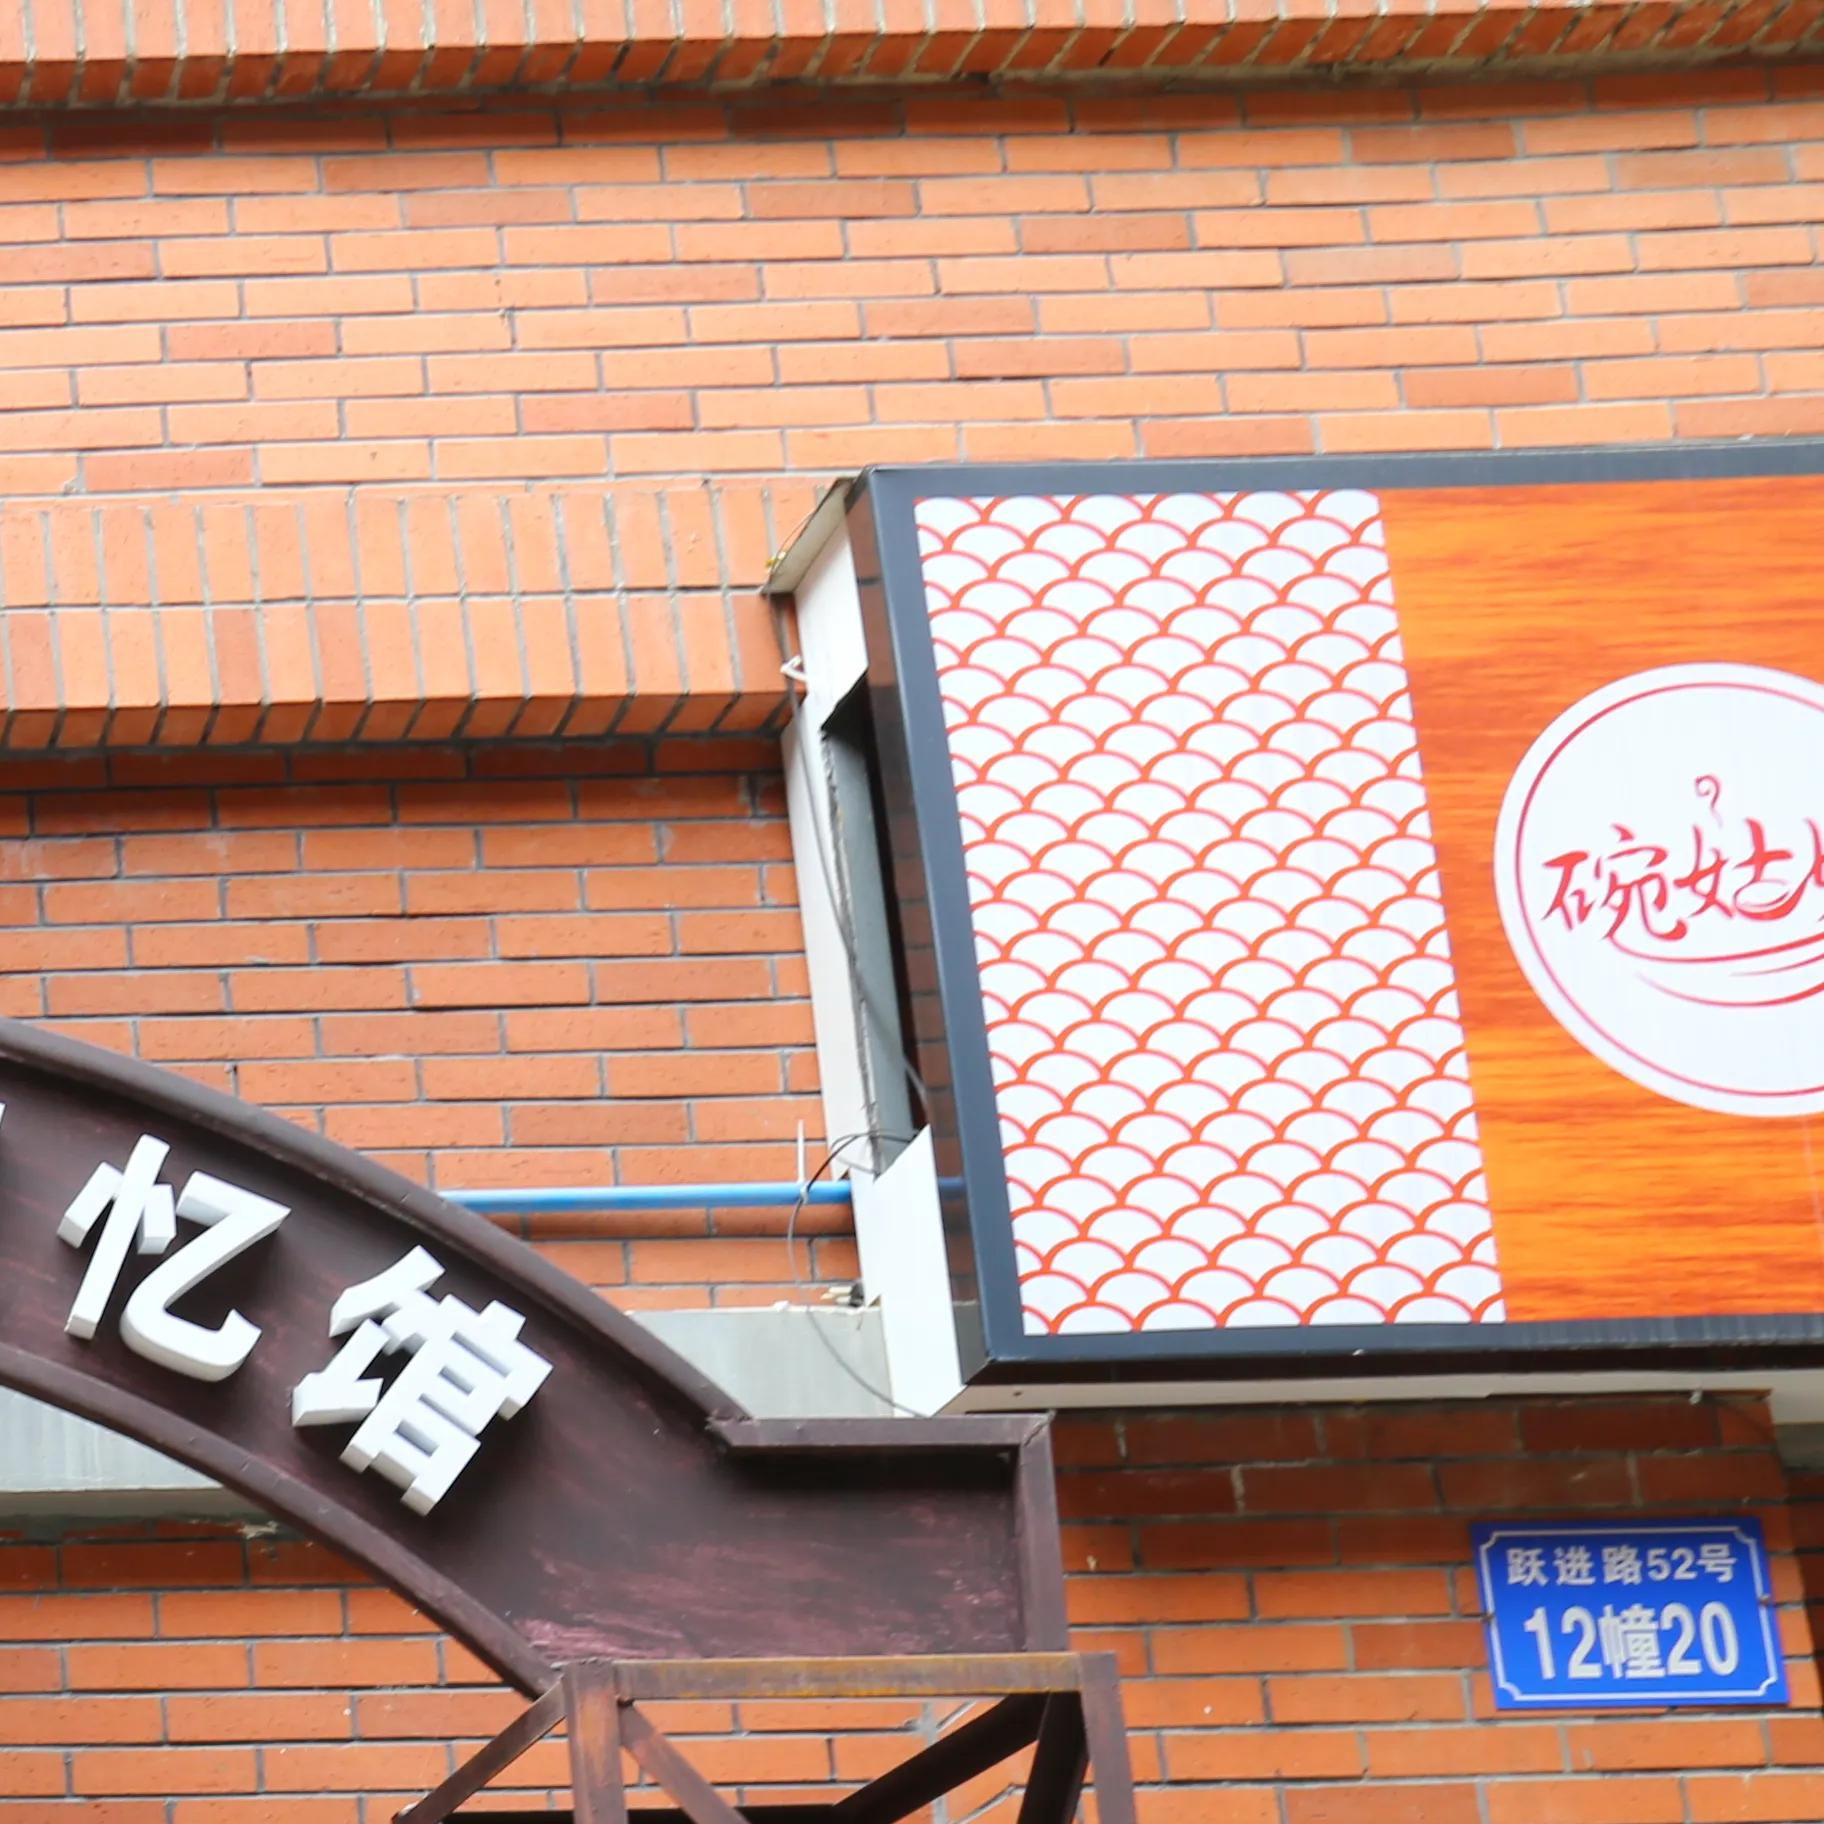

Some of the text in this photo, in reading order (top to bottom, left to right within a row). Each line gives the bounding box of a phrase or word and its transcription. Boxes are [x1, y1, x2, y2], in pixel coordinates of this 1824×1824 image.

[1505, 1543, 1739, 1587] 跃进路52号
[1523, 1600, 1740, 1680] 12幢20
